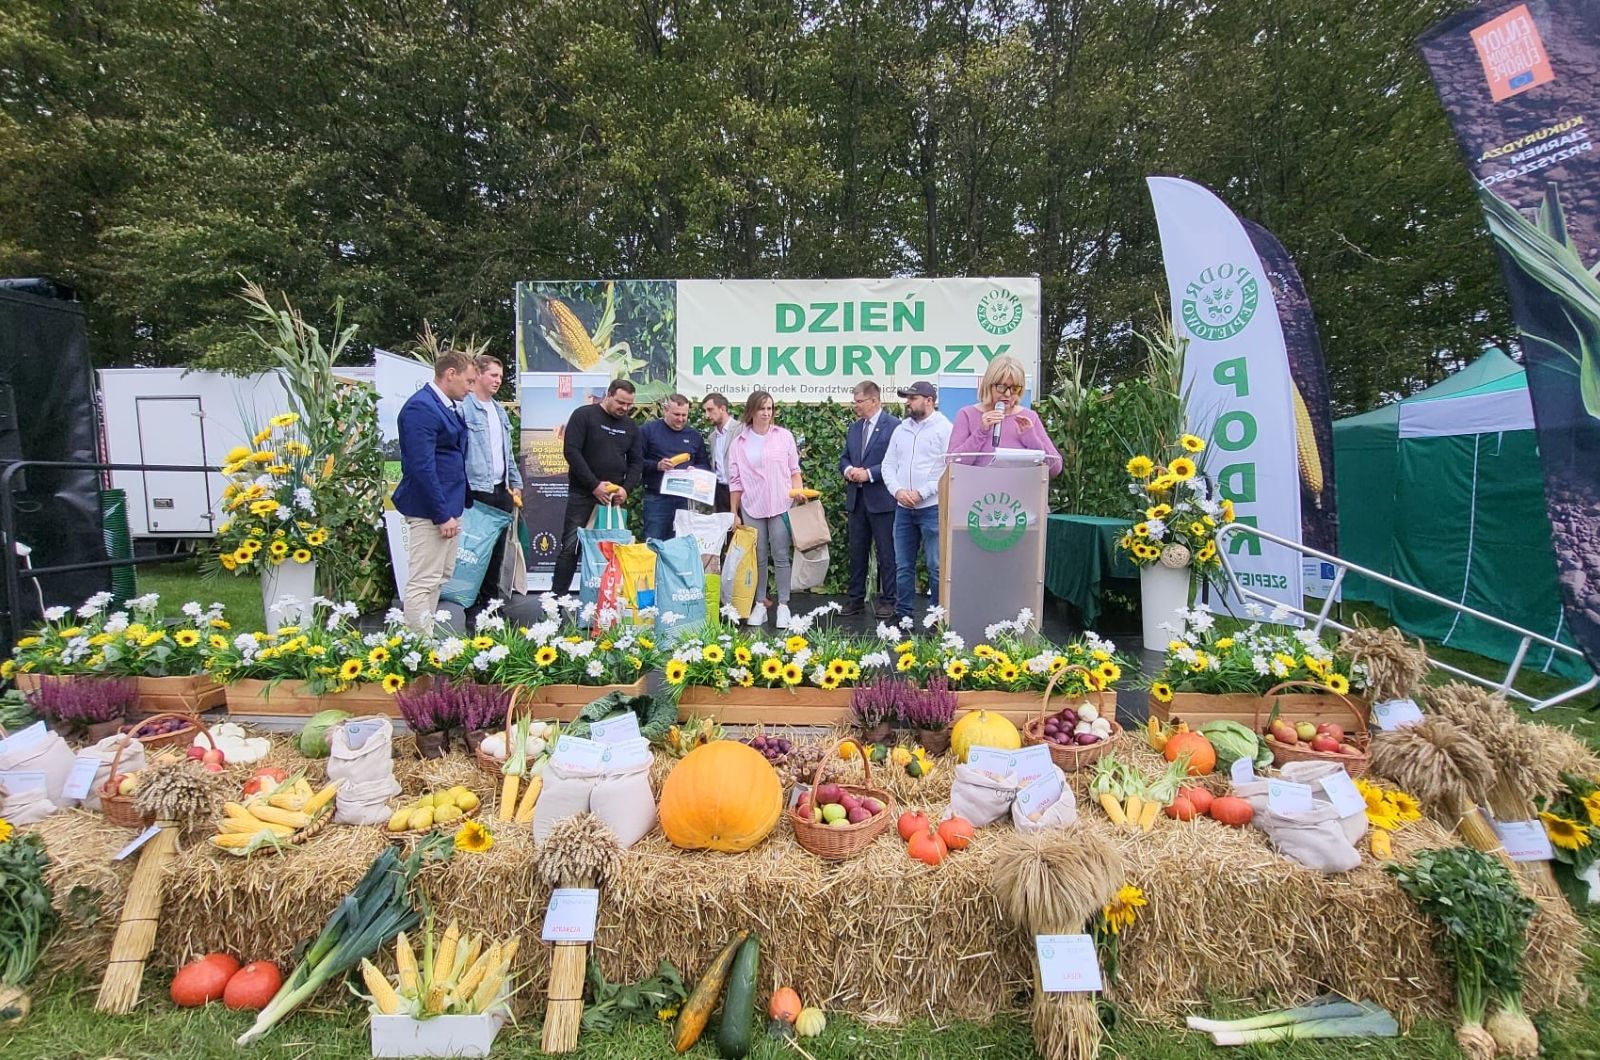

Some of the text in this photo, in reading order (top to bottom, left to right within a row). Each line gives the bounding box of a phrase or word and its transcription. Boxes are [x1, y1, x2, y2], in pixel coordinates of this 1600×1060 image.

[980, 288, 1020, 306] PODR
[775, 293, 925, 333] DZIEŃ
[976, 303, 1024, 335] SZEPIETOWO
[705, 384, 750, 393] Podlaski
[753, 384, 797, 393] Ośrodek
[800, 384, 855, 394] Doradztwa
[972, 492, 1022, 513] PODR
